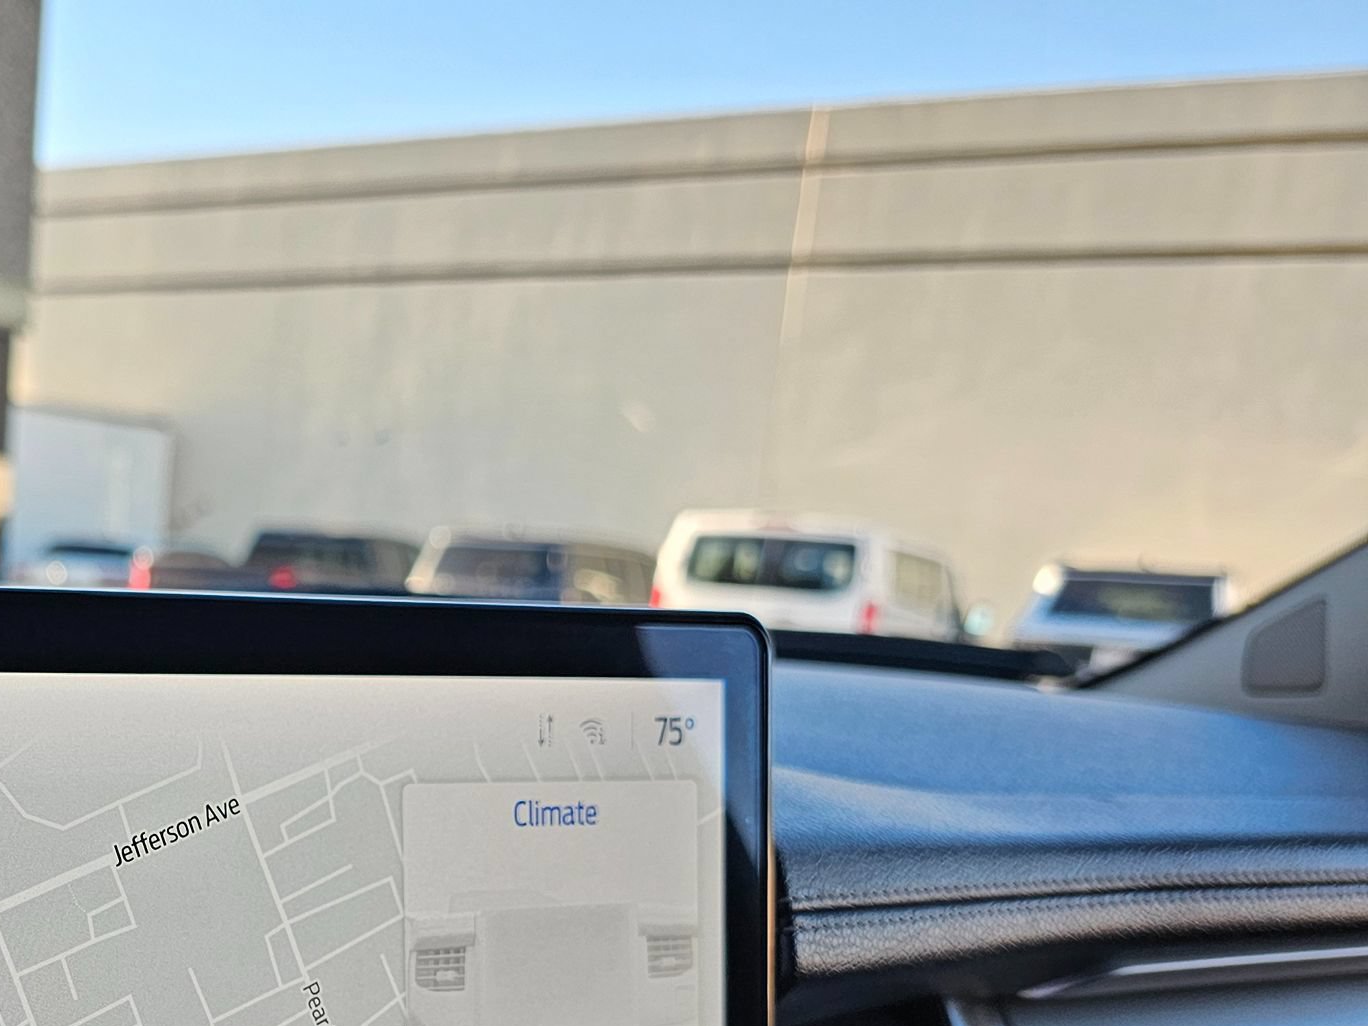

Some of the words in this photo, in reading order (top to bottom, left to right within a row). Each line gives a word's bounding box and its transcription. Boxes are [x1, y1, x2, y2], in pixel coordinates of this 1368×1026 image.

[654, 716, 695, 747] 75°
[513, 799, 598, 827] Climate
[113, 814, 202, 868] Jefferson
[204, 797, 242, 828] Ave
[303, 981, 329, 1026] Pear
